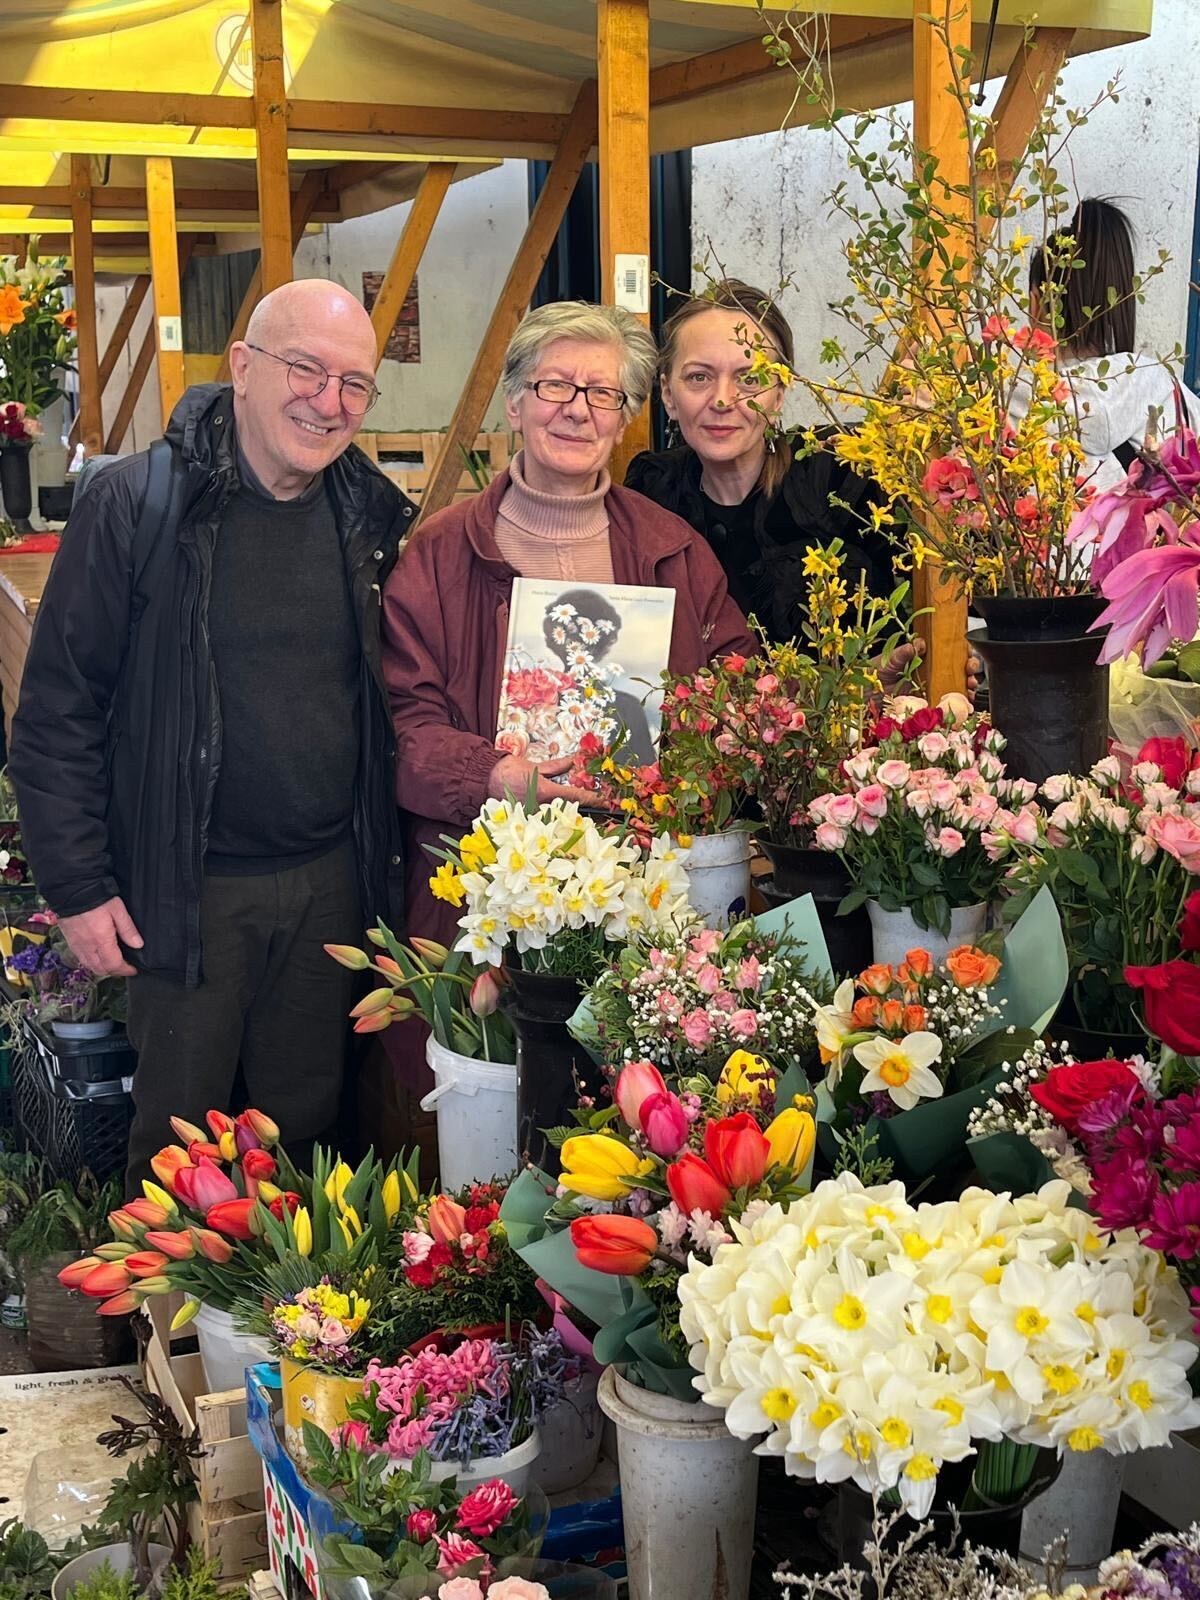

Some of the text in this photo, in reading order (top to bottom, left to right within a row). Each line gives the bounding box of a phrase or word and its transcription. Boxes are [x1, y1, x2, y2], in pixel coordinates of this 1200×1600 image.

[48, 1378, 79, 1388] fresh
[83, 1377, 93, 1385] &
[97, 1374, 132, 1385] grn
